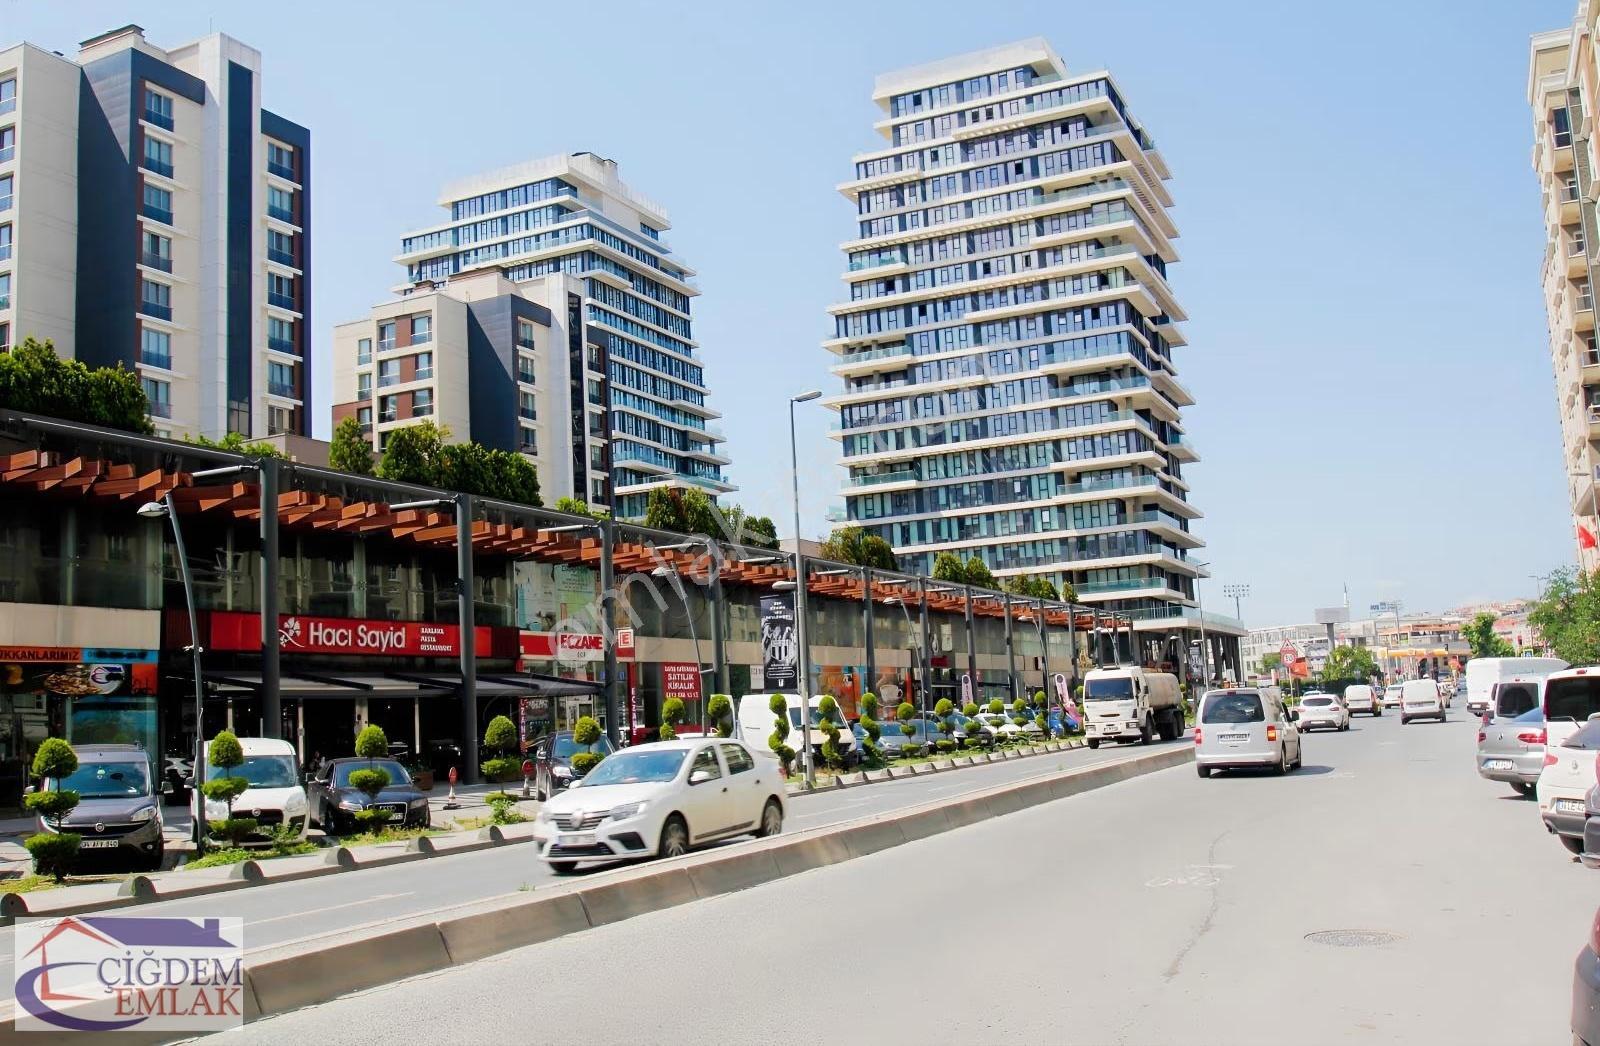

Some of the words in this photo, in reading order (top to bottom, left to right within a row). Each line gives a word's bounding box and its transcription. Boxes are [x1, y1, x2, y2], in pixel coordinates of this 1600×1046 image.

[309, 622, 352, 647] Hacı
[357, 623, 406, 652] Sayid
[561, 634, 603, 650] ECZANE
[667, 673, 695, 681] SATILIK
